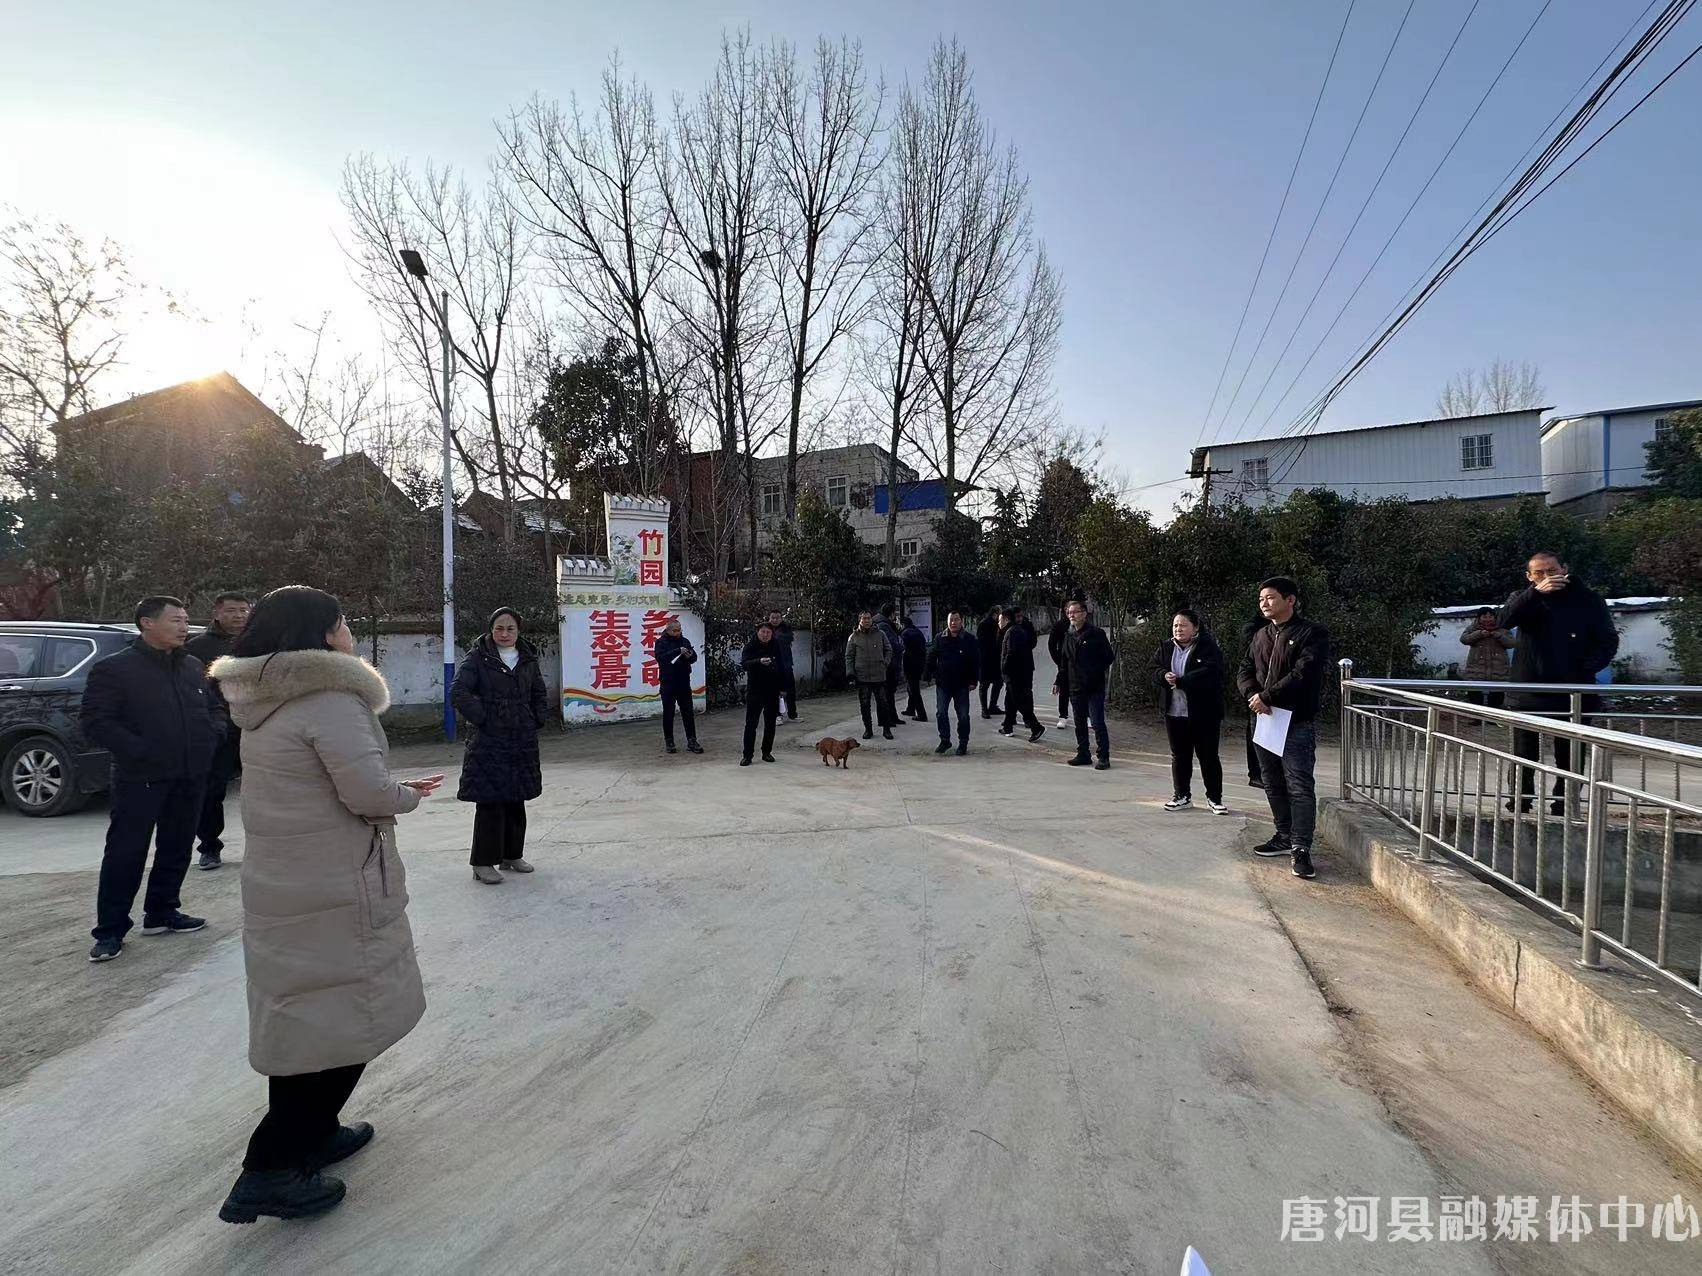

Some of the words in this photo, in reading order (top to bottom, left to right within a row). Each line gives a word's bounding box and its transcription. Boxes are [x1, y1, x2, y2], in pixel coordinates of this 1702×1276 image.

[638, 528, 664, 587] 竹园
[589, 609, 632, 690] 生态宜居
